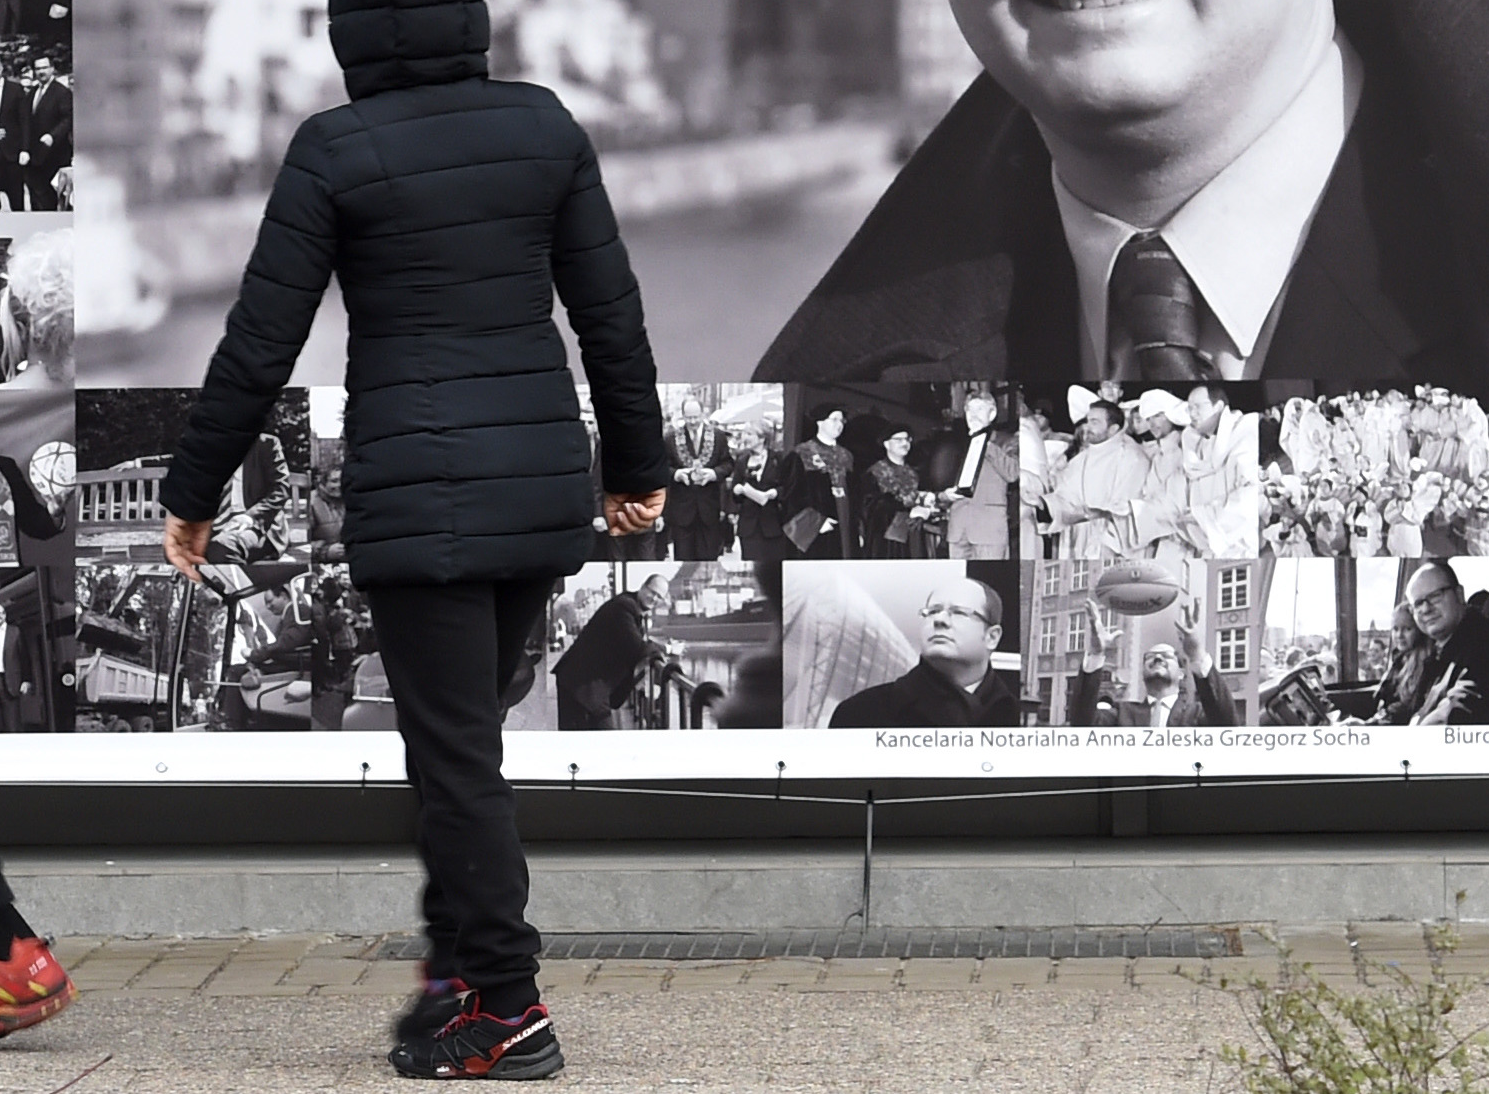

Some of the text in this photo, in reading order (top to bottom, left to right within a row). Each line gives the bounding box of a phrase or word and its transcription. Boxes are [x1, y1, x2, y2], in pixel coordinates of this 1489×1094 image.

[875, 728, 1371, 751] Kancelaria Notarialna Anna Zaleska Grzegorz Socha
[501, 1017, 551, 1052] SALOMO
